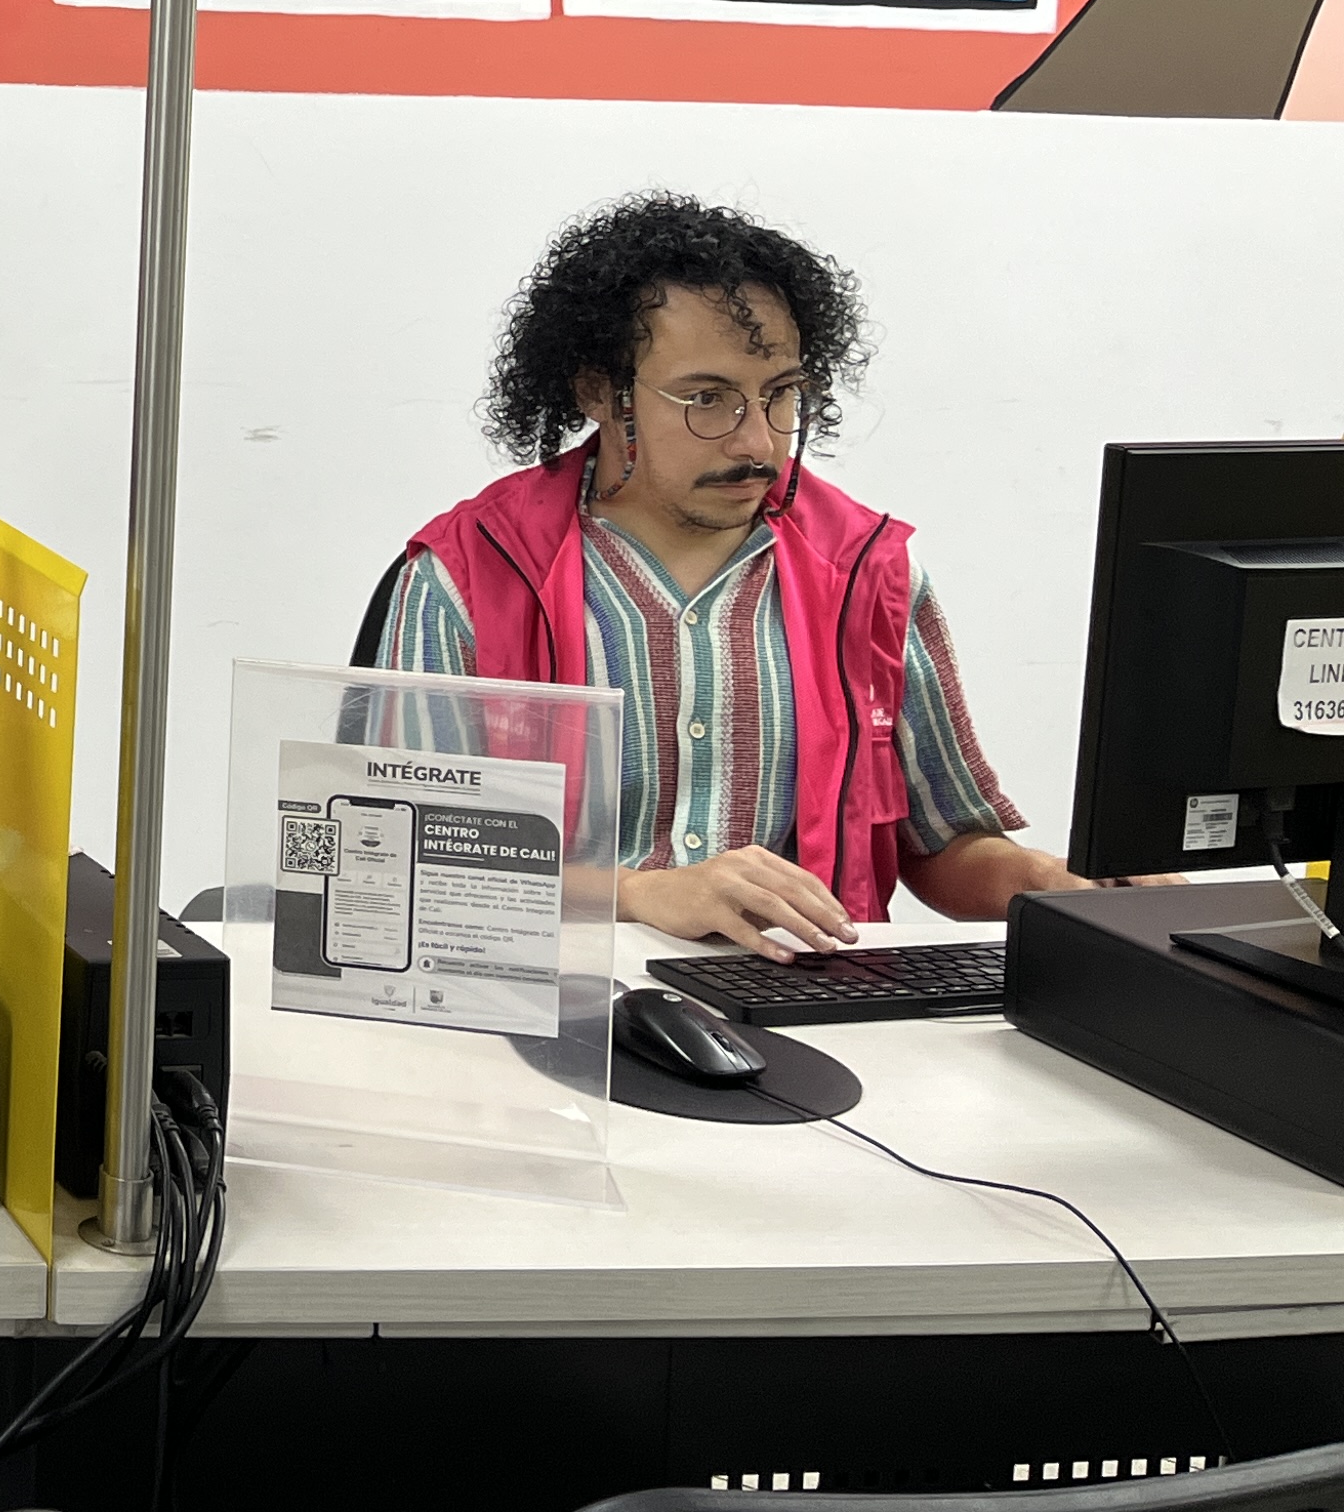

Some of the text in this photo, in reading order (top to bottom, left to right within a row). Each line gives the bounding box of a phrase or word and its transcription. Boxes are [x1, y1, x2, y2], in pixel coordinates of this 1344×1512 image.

[1309, 663, 1344, 683] LIN
[367, 760, 481, 786] INTÉGRATE
[425, 813, 518, 828] ¡CONÉCTATE CON EL
[424, 824, 479, 839] CENTRO
[424, 838, 555, 861] INTÉGRATE DE CALI!
